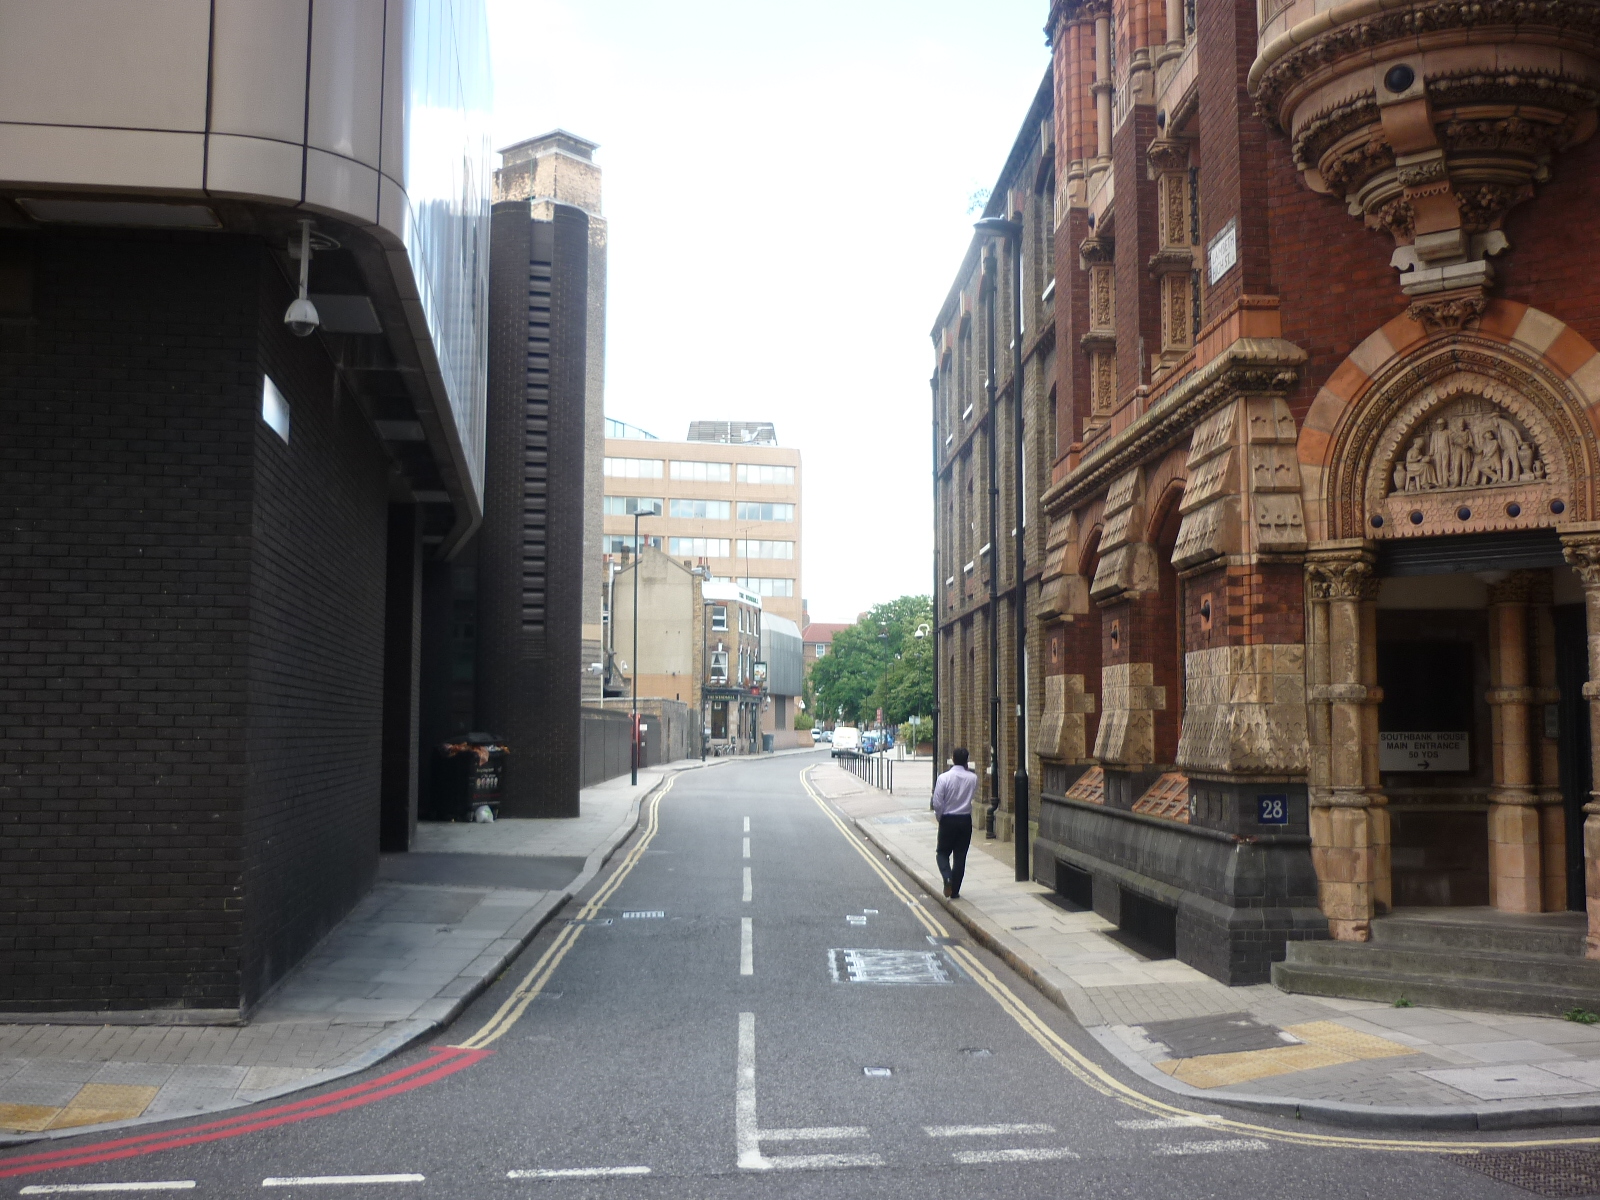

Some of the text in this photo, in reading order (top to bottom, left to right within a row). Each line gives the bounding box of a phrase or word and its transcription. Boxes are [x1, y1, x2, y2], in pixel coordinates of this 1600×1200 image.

[1212, 234, 1235, 265] LAMBETH
[1380, 733, 1466, 741] SOUTHBANK HOUSE
[1386, 742, 1460, 750] MAIN ENTRANCE
[1408, 751, 1439, 759] 50 YDS
[1262, 800, 1283, 819] 28
